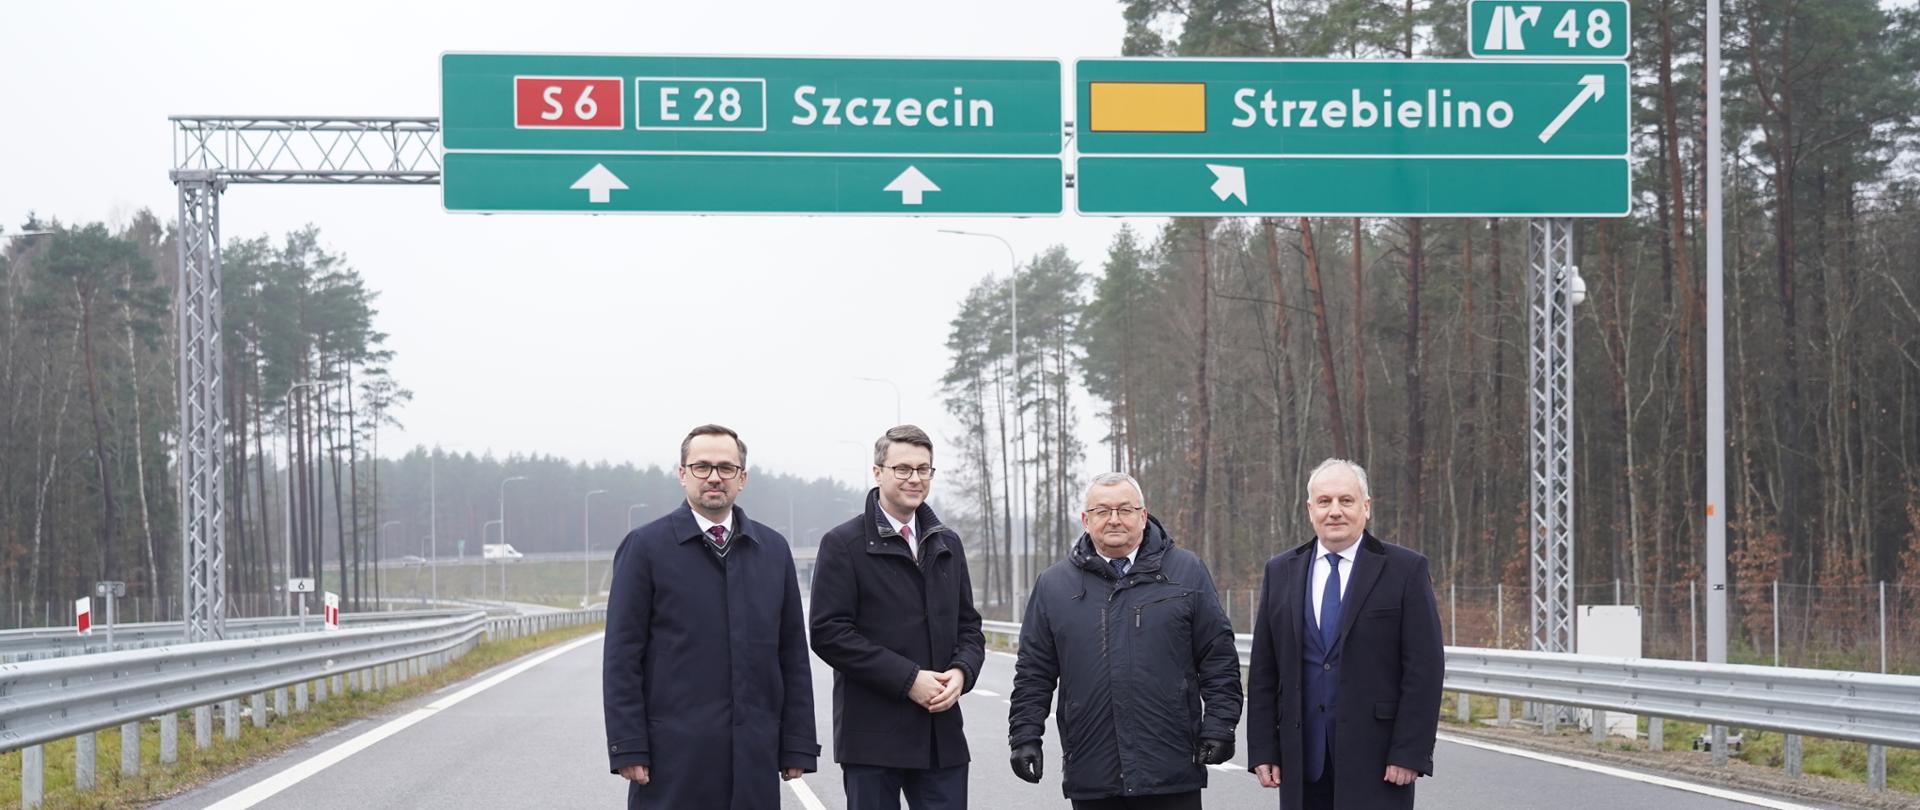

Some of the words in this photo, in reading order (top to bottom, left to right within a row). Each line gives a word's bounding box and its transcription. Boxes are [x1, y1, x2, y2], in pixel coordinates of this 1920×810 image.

[1553, 8, 1612, 49] 48
[541, 86, 563, 121] S
[574, 85, 598, 120] 6
[660, 87, 680, 121] E
[693, 87, 742, 122] 28
[791, 85, 994, 127] Szczecin
[1231, 87, 1514, 129] Strzebielino
[298, 580, 305, 590] 6
